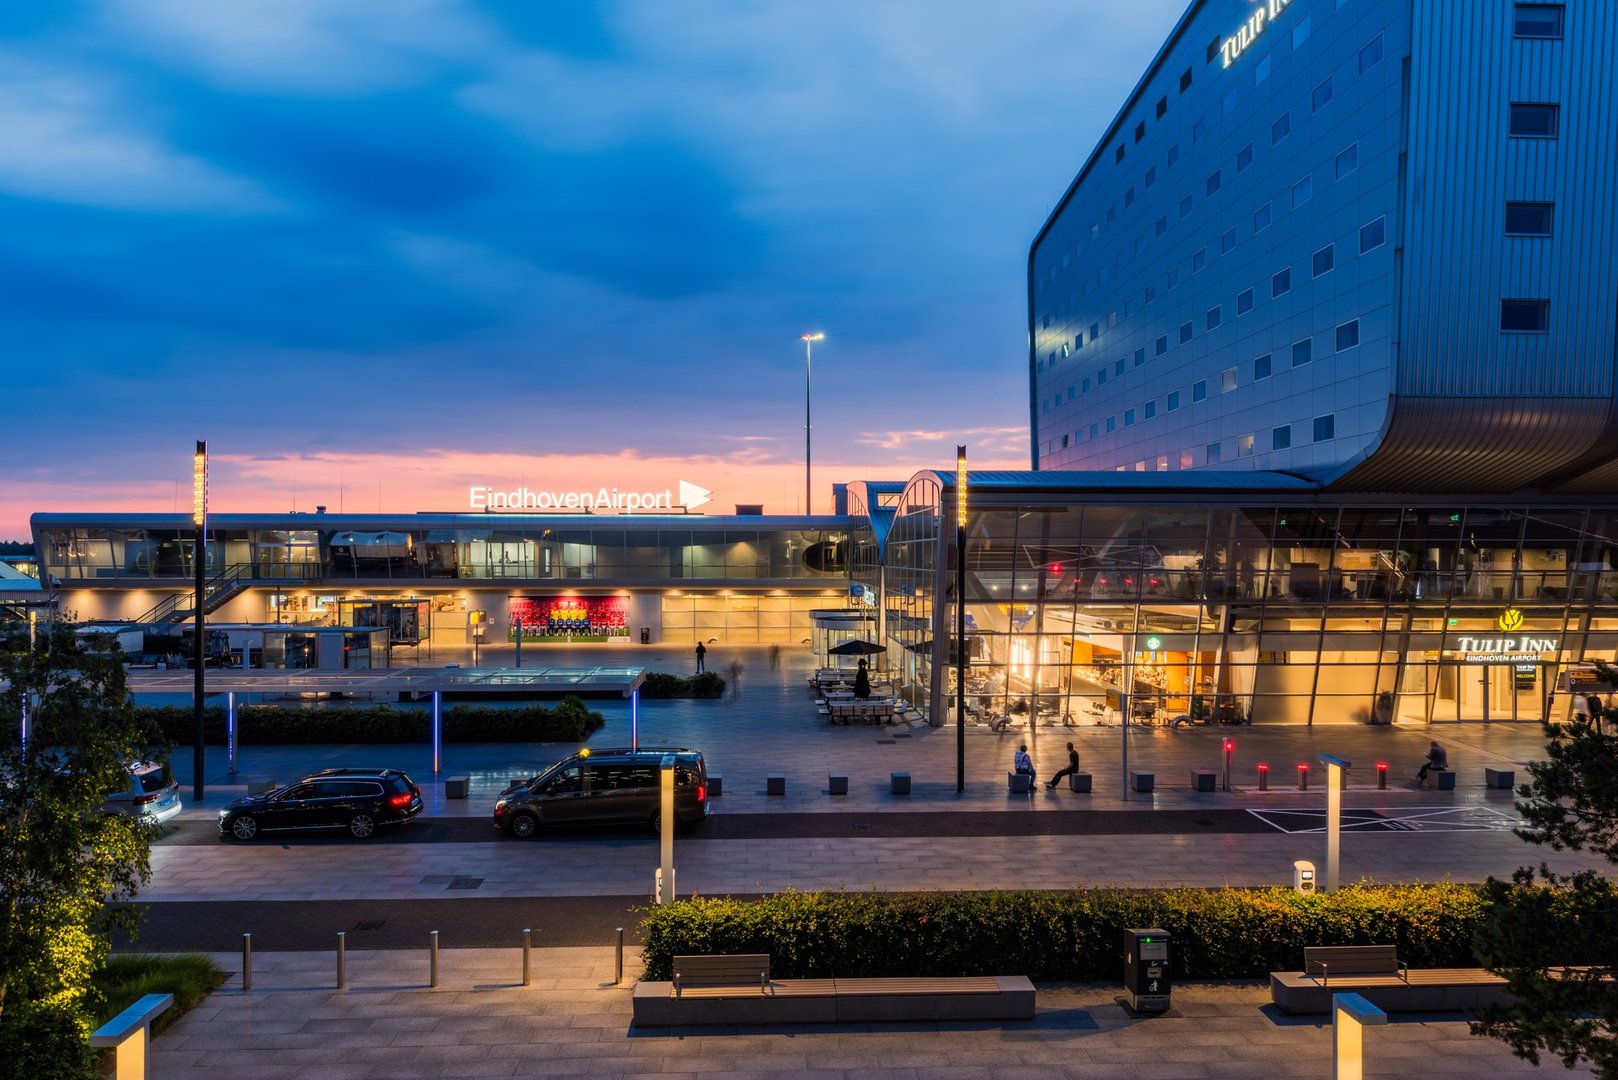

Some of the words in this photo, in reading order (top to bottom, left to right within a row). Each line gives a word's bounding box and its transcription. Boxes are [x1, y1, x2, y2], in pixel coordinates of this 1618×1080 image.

[1221, 7, 1265, 69] TULIP
[470, 487, 672, 514] EindhovenAirport
[1457, 636, 1515, 653] TULIP
[1520, 636, 1557, 653] INN
